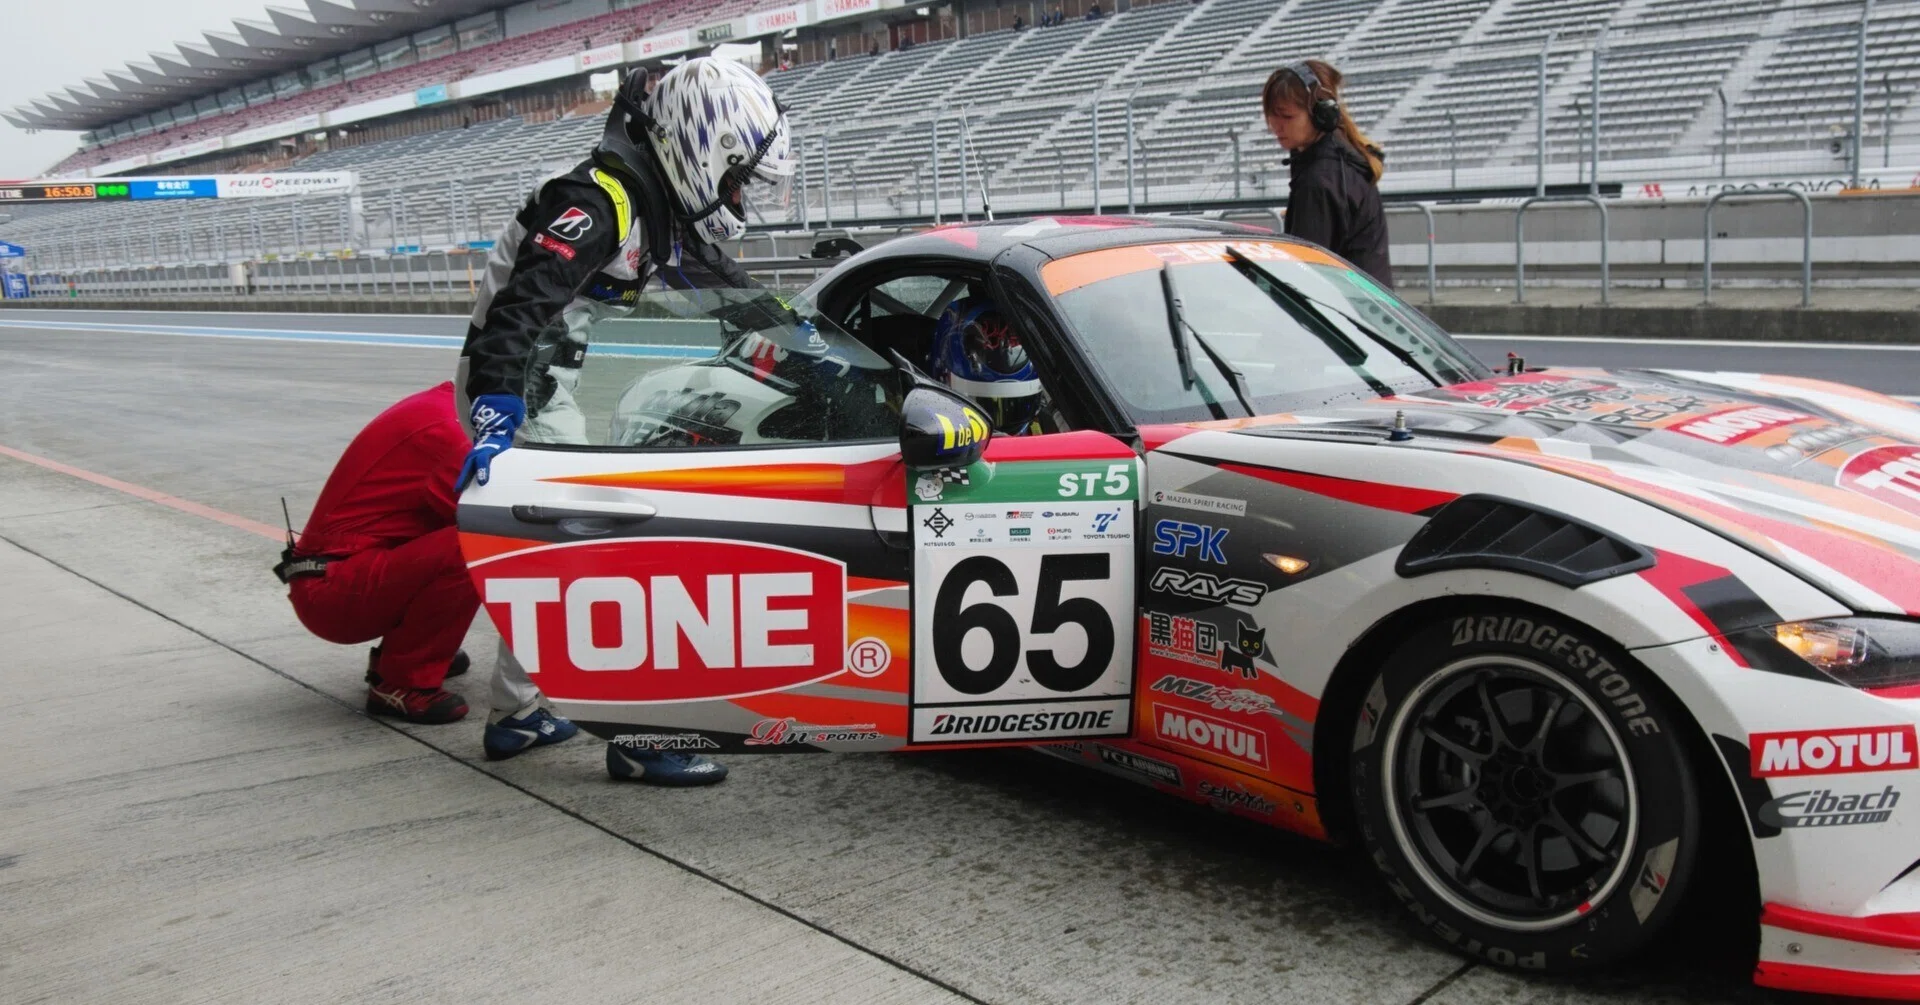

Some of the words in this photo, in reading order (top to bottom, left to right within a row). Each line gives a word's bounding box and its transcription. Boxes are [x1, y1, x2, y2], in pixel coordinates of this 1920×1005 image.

[765, 10, 797, 28] YAMAHA
[44, 186, 93, 198] 16:50.8
[229, 179, 259, 188] FUJI
[1166, 495, 1192, 504] MAZDA
[1193, 498, 1215, 508] SPIRIT
[1216, 501, 1244, 512] RACING
[1153, 519, 1230, 565] SPK
[1151, 568, 1267, 605] RAYS
[484, 571, 815, 674] TONE
[932, 552, 1115, 695] 65
[1150, 611, 1218, 656] 黒猫団
[1452, 615, 1661, 737] BRIDGESTONE
[930, 709, 1114, 735] BRIDGESTONE
[1161, 711, 1262, 762] MOTUL
[1759, 732, 1912, 772] MOTUL
[1758, 785, 1901, 828] Eibach
